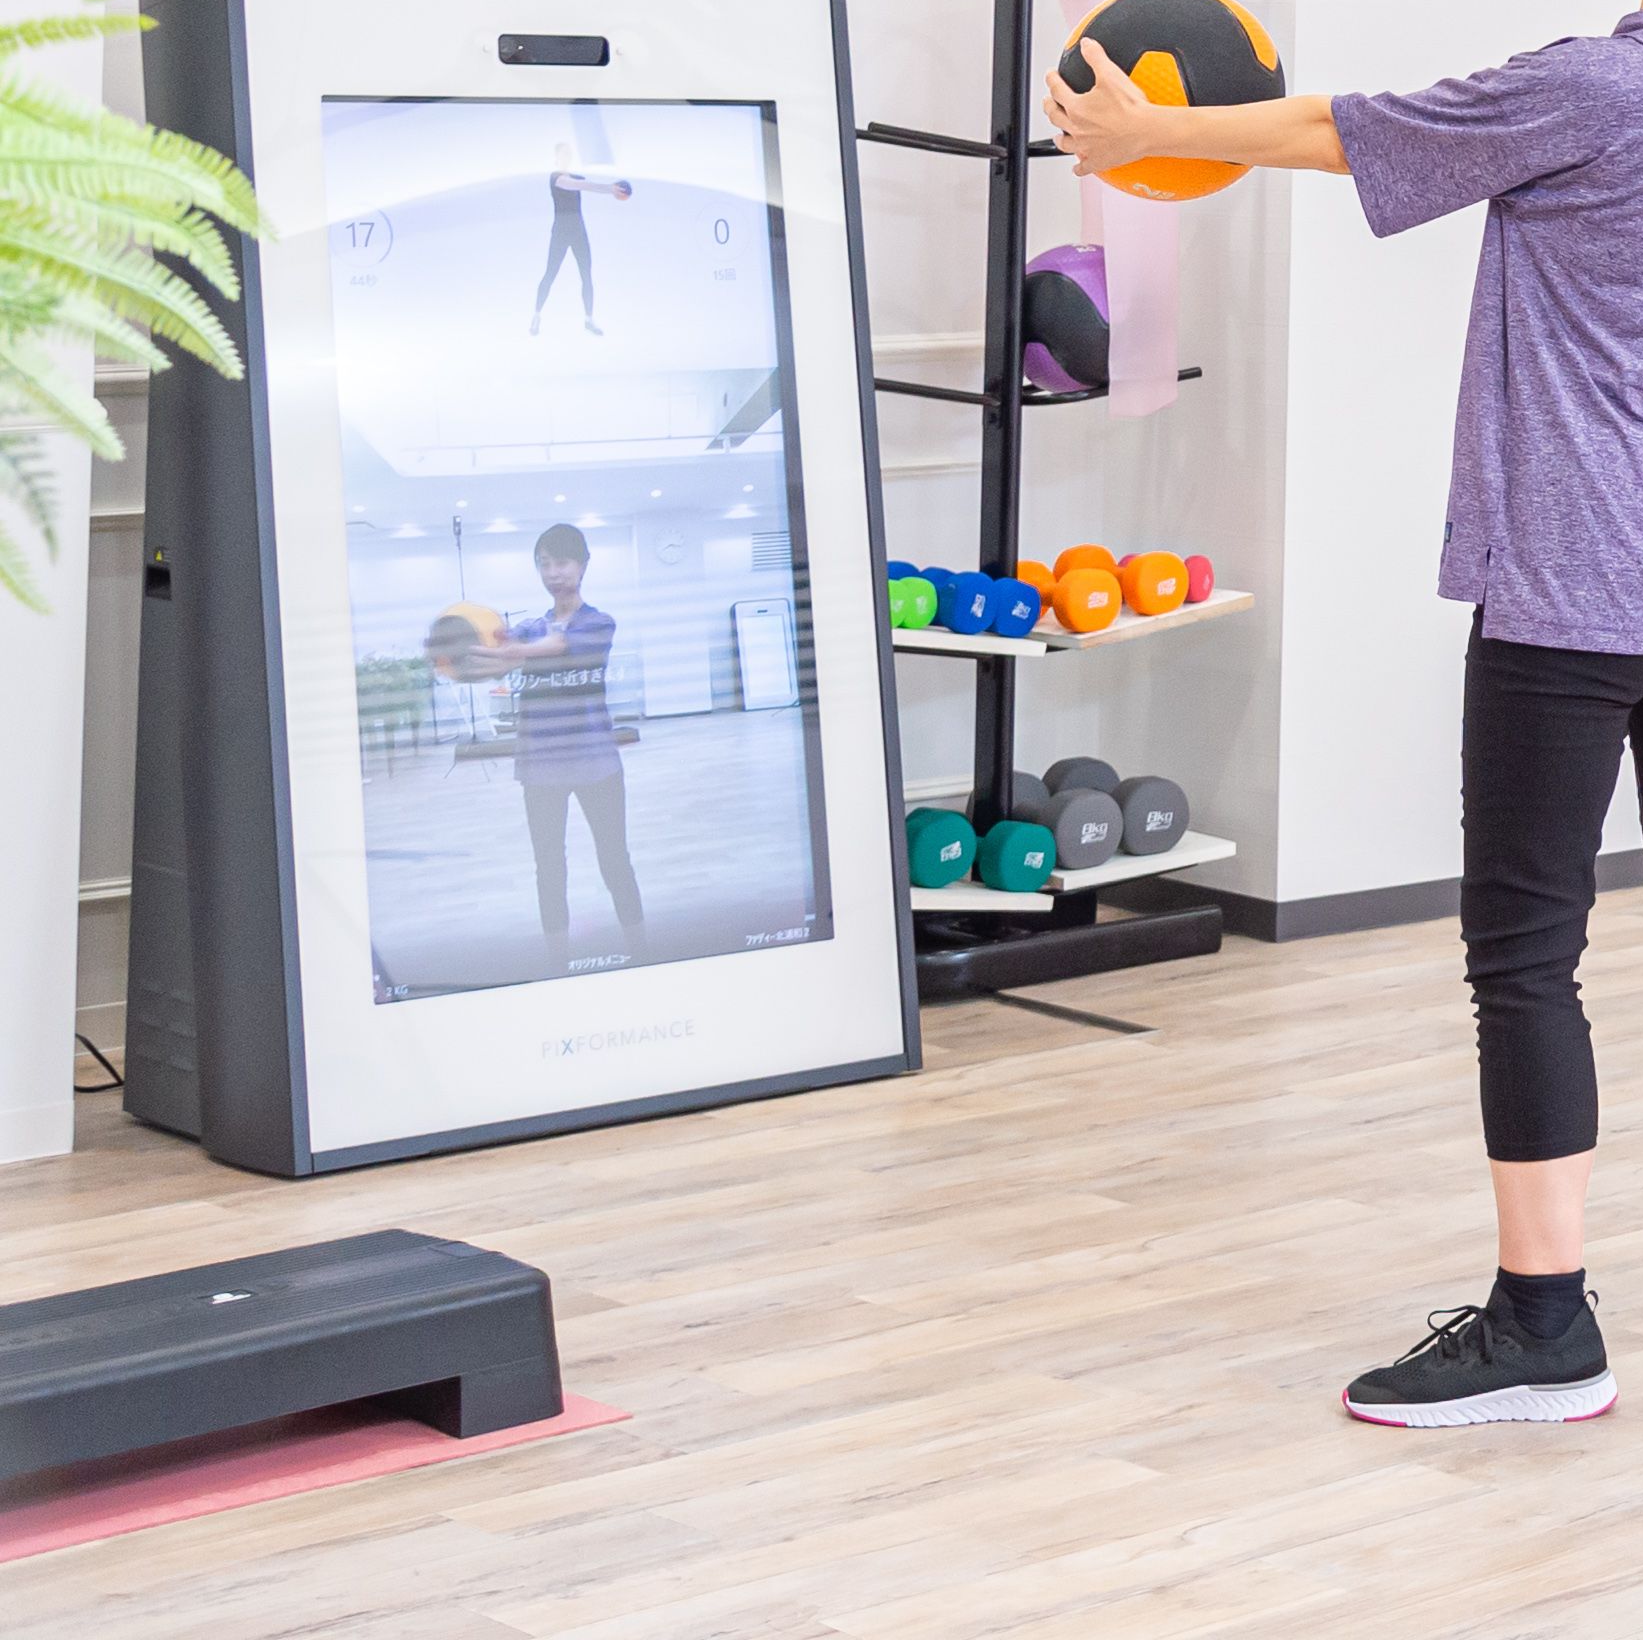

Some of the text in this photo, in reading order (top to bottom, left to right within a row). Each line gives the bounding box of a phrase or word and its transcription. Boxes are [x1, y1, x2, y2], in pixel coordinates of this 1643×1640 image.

[345, 221, 375, 248] 17
[714, 218, 730, 245] 0
[541, 1018, 696, 1059] PIXFORMANCE
